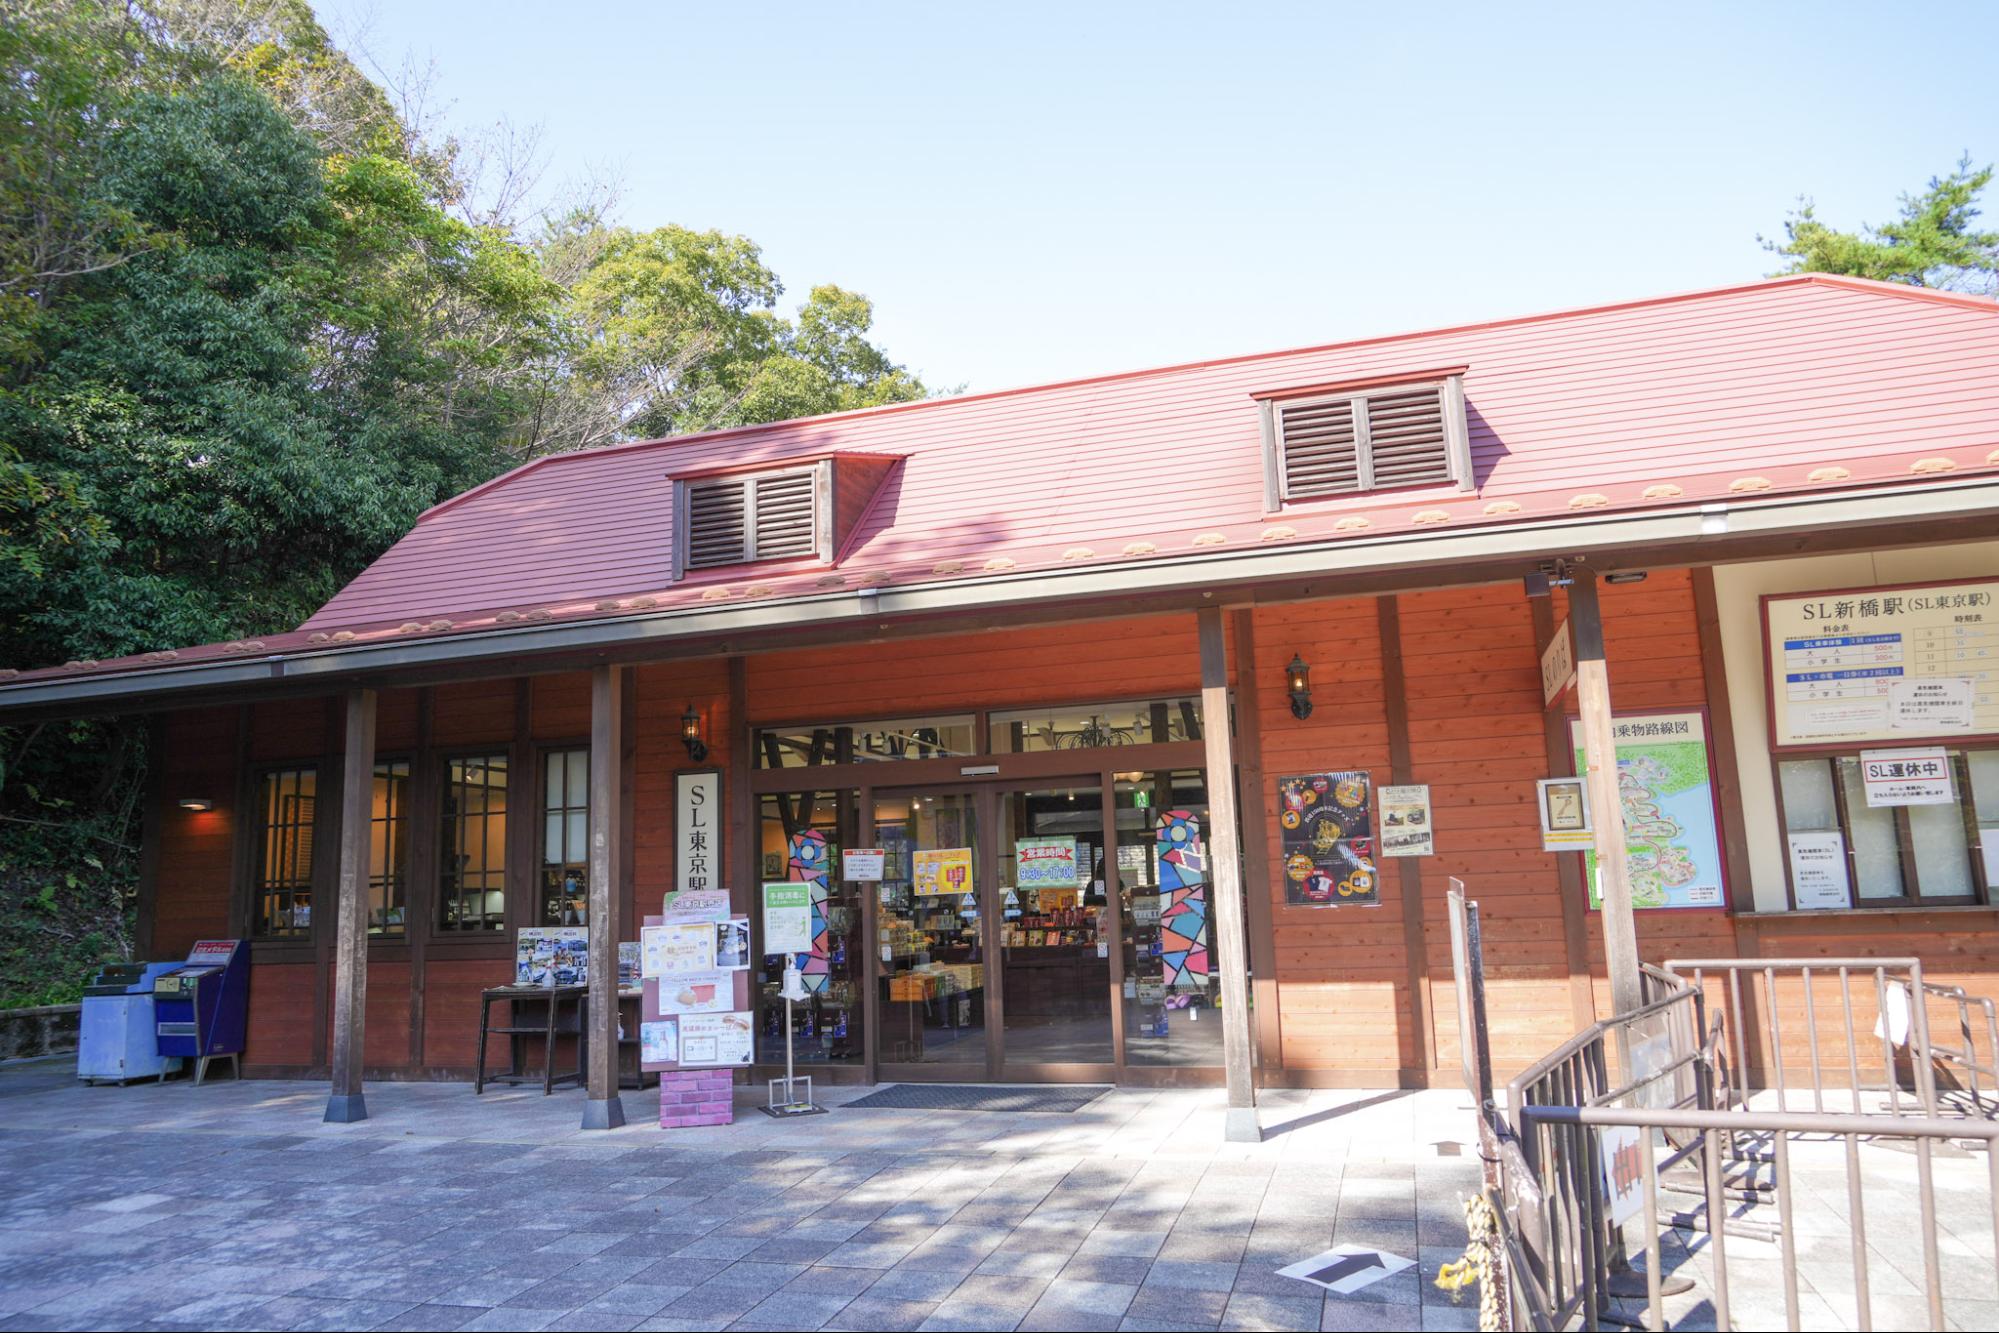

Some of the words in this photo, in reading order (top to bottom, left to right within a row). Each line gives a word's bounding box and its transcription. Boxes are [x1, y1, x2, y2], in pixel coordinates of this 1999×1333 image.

[1954, 614, 1983, 623] 時刻表
[1823, 625, 1850, 633] 料金表
[1612, 720, 1689, 738] 乗物路線図
[1870, 762, 1938, 777] SL運休中
